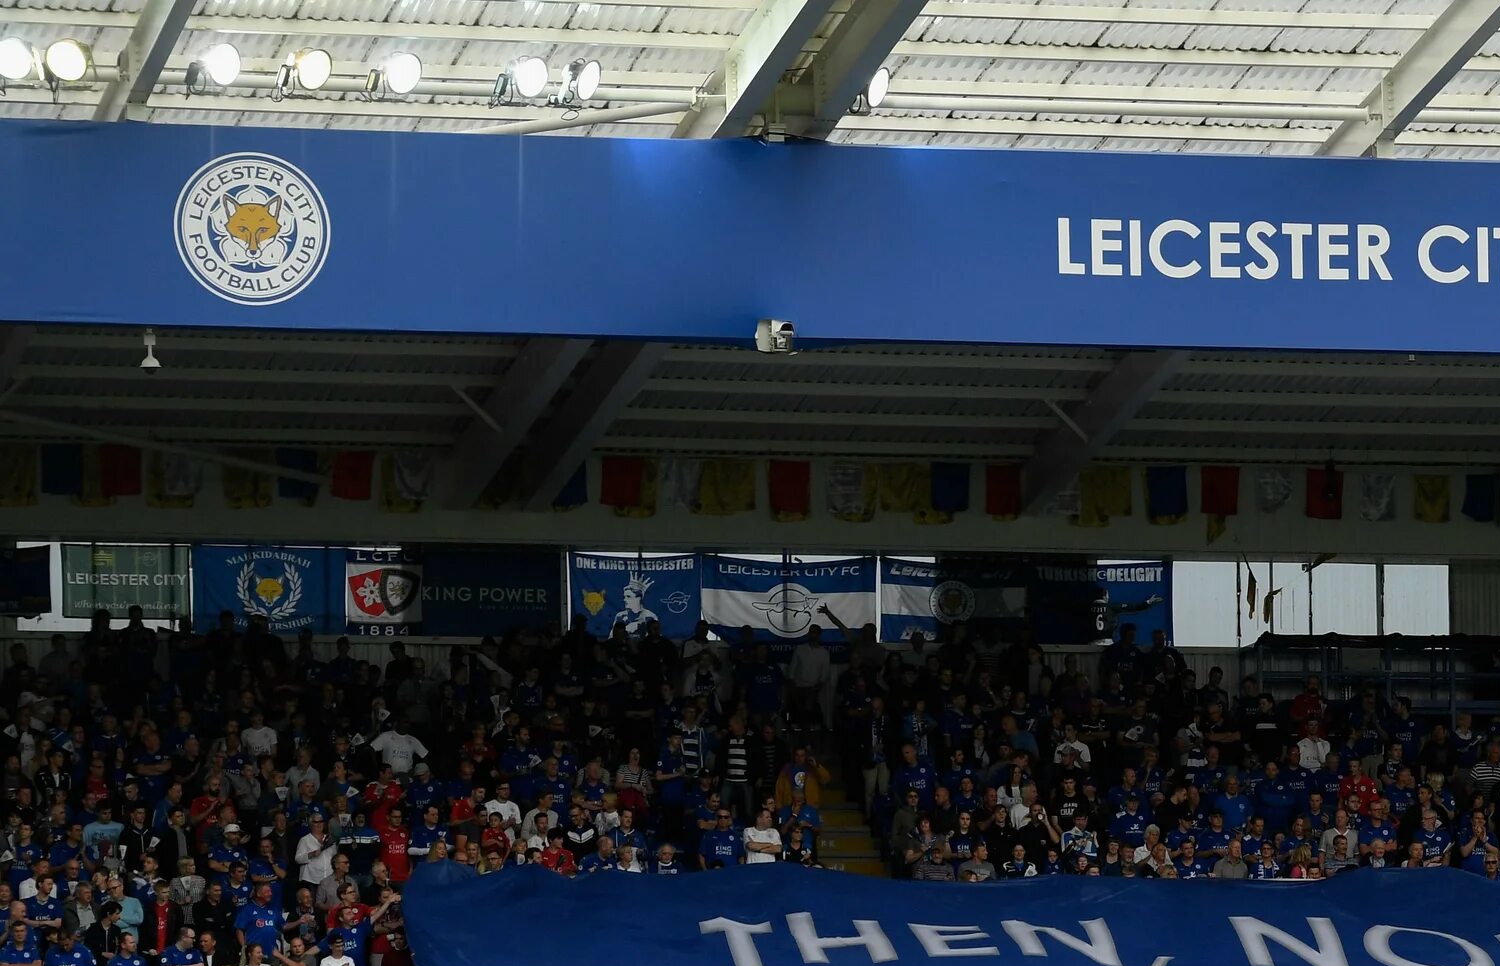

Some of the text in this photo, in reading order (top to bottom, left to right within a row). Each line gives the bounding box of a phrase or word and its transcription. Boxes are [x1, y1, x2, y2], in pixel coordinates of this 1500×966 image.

[189, 165, 317, 225] LEICESTER CITY
[1057, 216, 1393, 281] LEICESTER
[188, 232, 316, 293] FOOTBALL CLUB
[576, 557, 597, 570] ONE
[599, 557, 625, 571] KING
[641, 557, 695, 571] LEICESTER
[841, 565, 860, 576] FC
[67, 572, 187, 586] LEICESTER CITY
[1106, 566, 1164, 583] DELIGHT
[421, 585, 548, 603] KING POWER
[1095, 614, 1104, 631] 6
